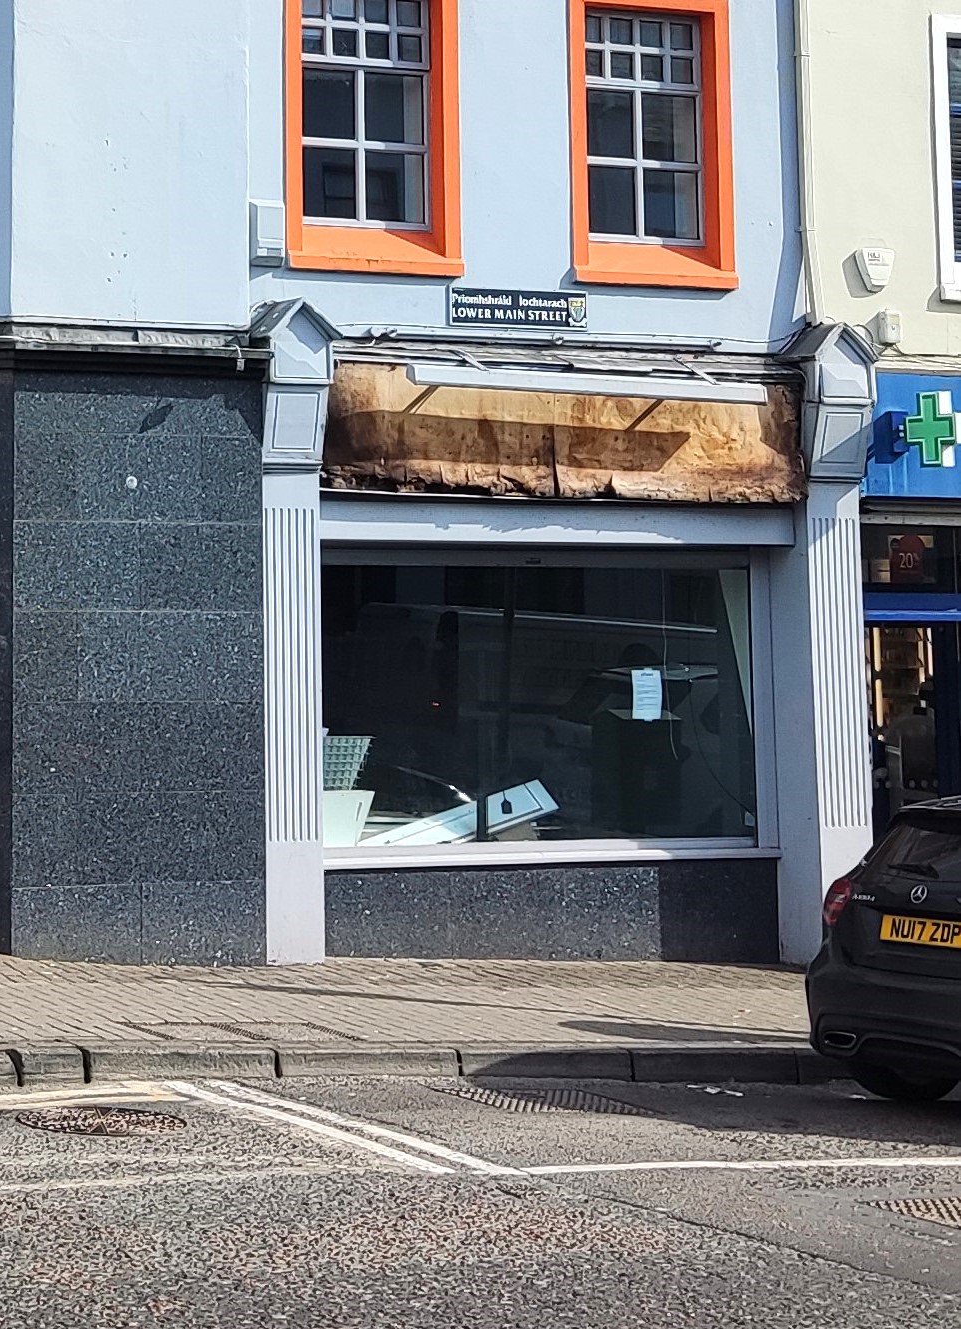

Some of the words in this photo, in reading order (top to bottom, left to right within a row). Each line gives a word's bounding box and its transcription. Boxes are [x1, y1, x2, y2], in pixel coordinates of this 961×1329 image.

[452, 307, 492, 319] LOWER
[494, 308, 526, 320] MAIN
[528, 309, 568, 322] STREET
[889, 917, 927, 941] NU17
[928, 921, 961, 945] ZDP
